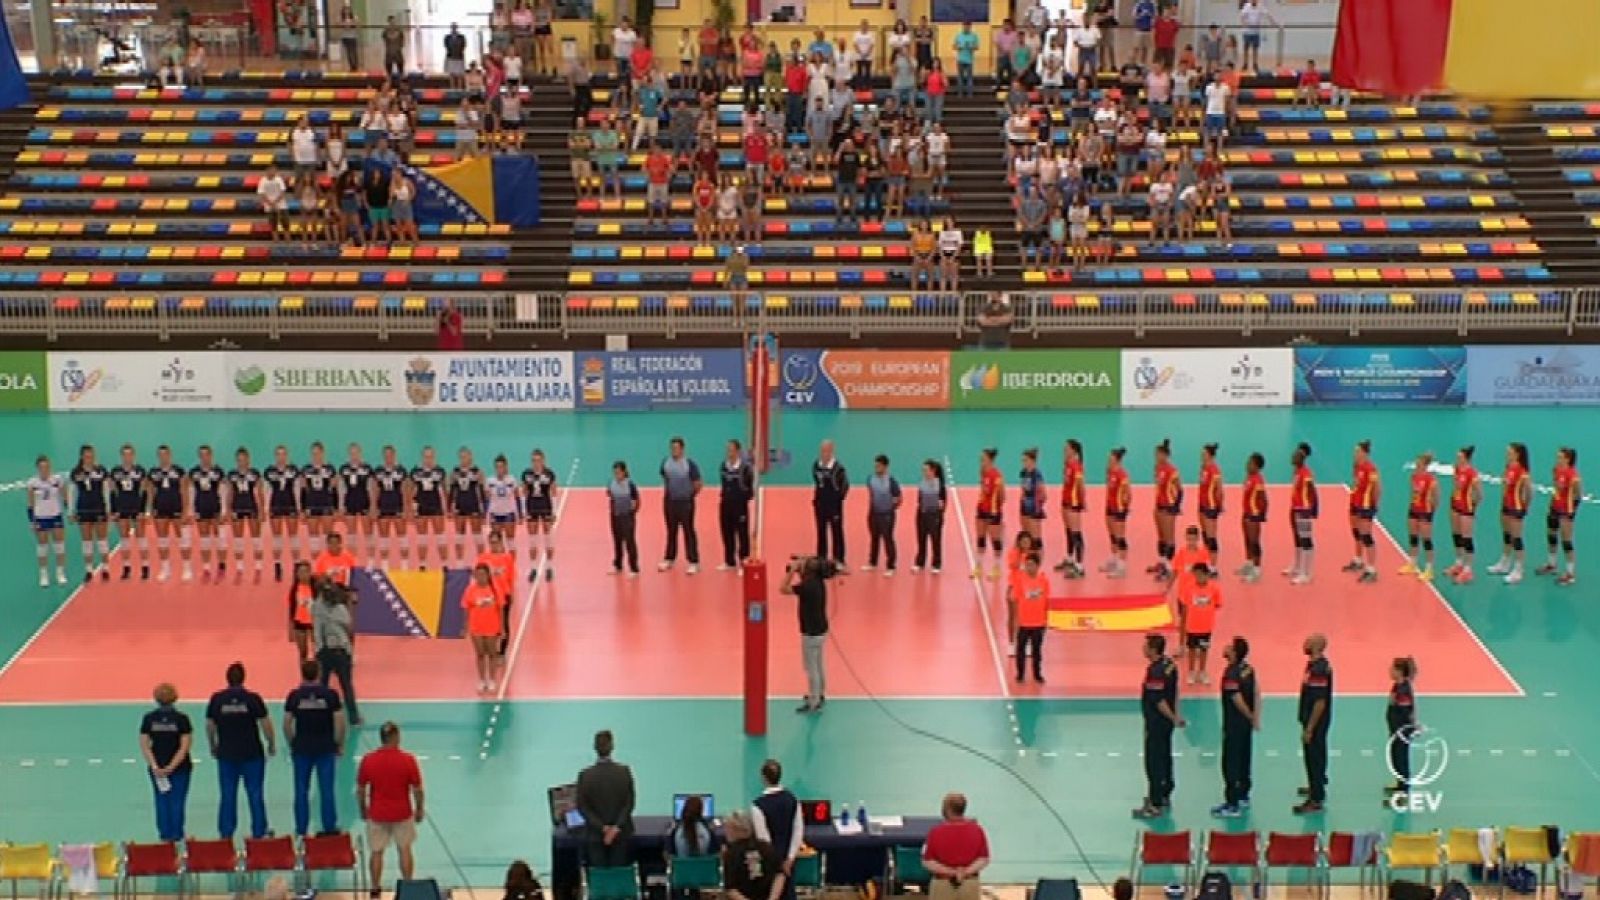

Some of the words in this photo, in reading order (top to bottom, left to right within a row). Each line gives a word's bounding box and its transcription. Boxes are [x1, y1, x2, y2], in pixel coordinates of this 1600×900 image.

[448, 358, 562, 377] AYUNTAMIENTO
[611, 356, 637, 372] REAL
[639, 353, 703, 371] FEDERACIÓN
[871, 361, 940, 375] EUROPEAN
[273, 368, 392, 387] SBERBANK
[612, 376, 664, 396] ESPAÑOLA
[682, 379, 732, 395] VOLEIBOL
[1002, 371, 1113, 389] IBERDROLA
[439, 382, 458, 402] DE
[464, 382, 573, 402] GUADALAJARA
[785, 391, 815, 403] CEV
